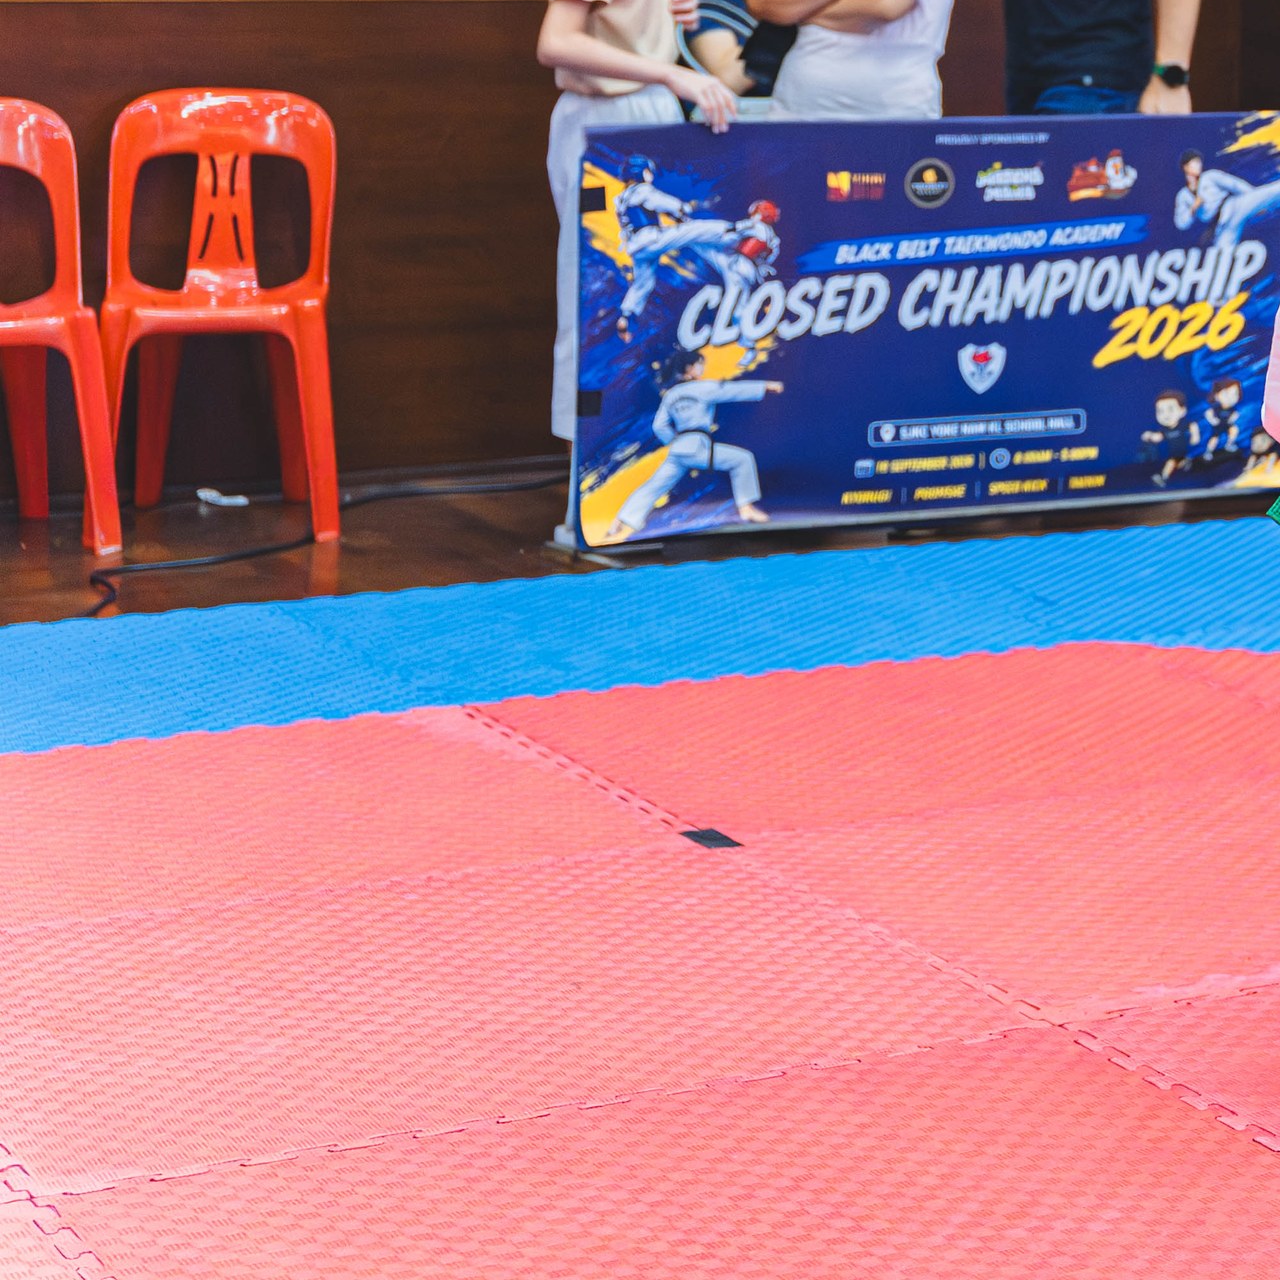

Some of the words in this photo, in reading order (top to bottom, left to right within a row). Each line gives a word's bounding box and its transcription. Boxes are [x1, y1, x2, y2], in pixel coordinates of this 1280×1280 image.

[835, 244, 892, 265] BLACK
[896, 237, 941, 260] BELT
[944, 229, 1048, 255] TAEKWONDO
[1049, 222, 1125, 246] ACADEMY
[676, 269, 890, 351] CLOSED
[899, 239, 1268, 332] CHAMPIONSHIP
[1091, 291, 1250, 369] 2026
